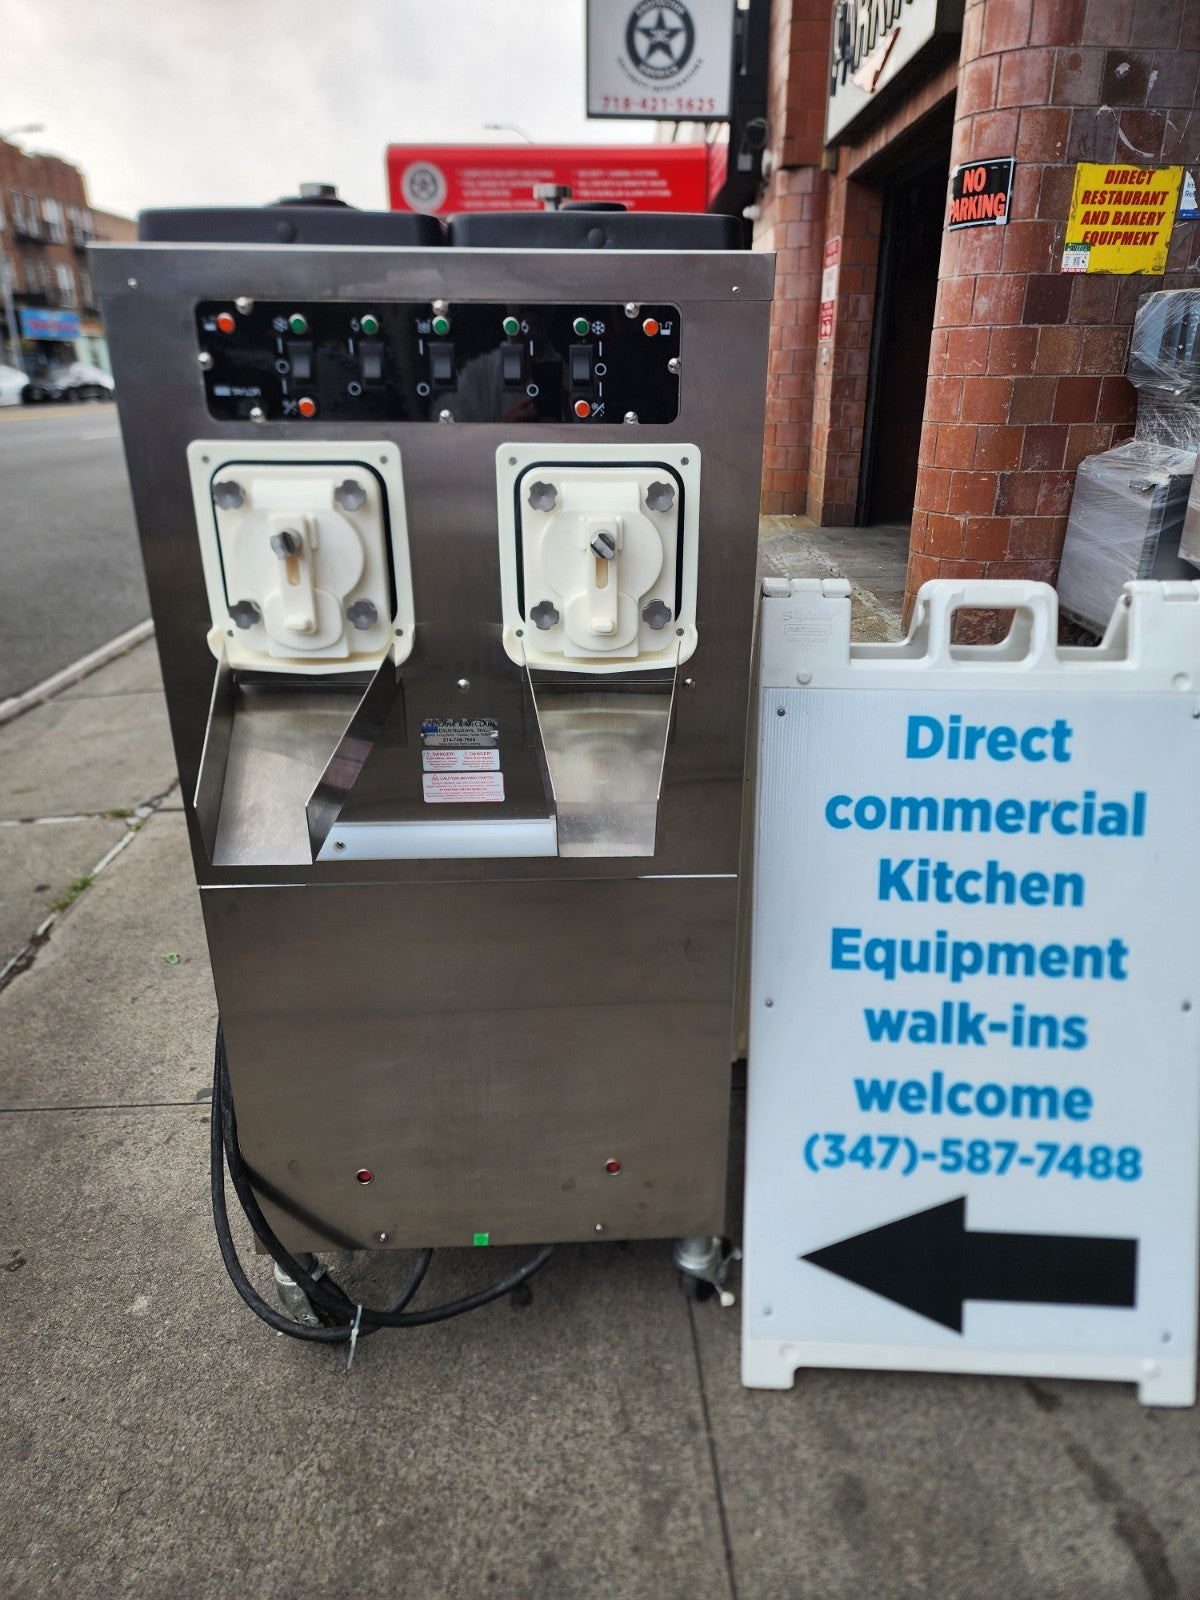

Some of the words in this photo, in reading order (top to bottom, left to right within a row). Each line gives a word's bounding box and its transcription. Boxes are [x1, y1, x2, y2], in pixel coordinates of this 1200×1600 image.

[963, 167, 987, 194] NO
[1081, 190, 1169, 206] RESTAURANT
[1104, 169, 1156, 185] DIRECT
[949, 192, 1006, 223] PARKING
[1080, 210, 1111, 226] AND
[1111, 211, 1166, 226] BAKERY
[1081, 231, 1160, 246] EQUIPMENT
[906, 714, 1073, 763] Direct
[825, 790, 1147, 837] commercial
[878, 857, 1085, 907] Kitchen
[830, 927, 1129, 983] Equipment
[864, 1001, 1088, 1050] walk-ins
[854, 1070, 1093, 1121] welcome
[803, 1133, 1142, 1182] (347)-587-7488
